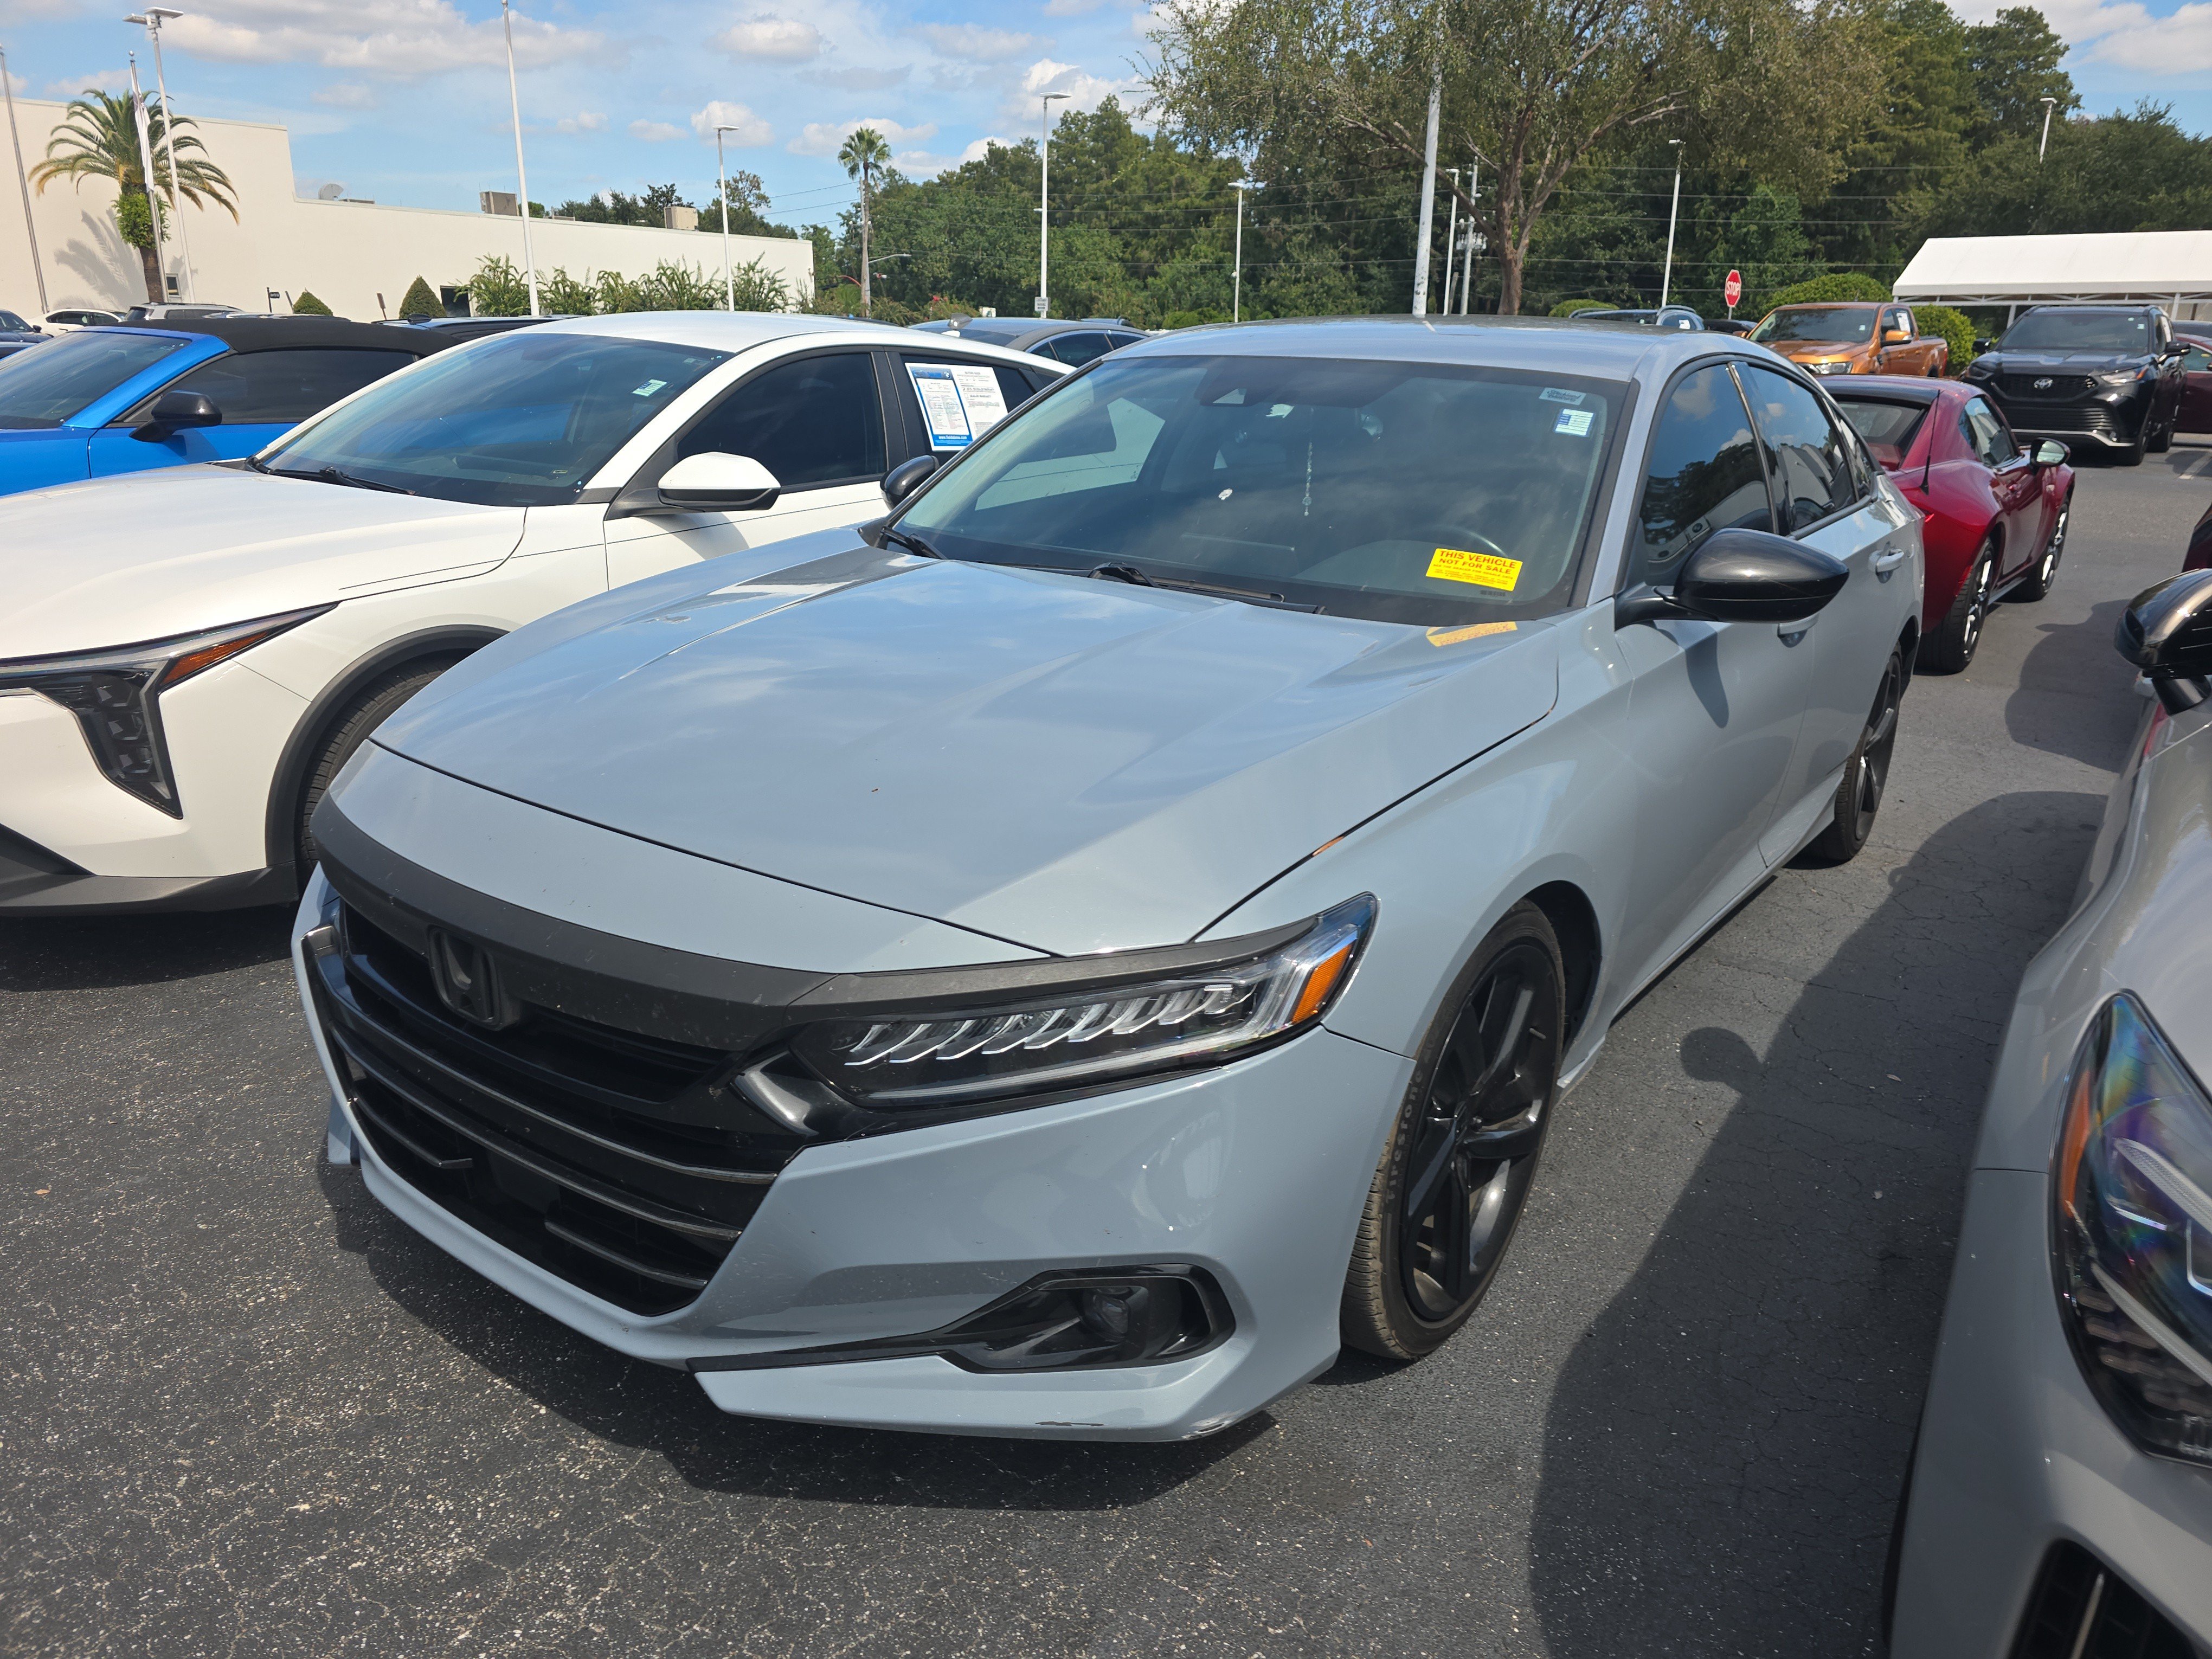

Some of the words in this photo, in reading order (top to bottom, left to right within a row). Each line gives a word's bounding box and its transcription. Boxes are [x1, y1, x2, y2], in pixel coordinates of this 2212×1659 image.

[1726, 280, 1740, 296] STOP
[1440, 550, 1464, 559] THIS
[1469, 555, 1517, 569] VEHICLE
[1486, 565, 1511, 574] SALE
